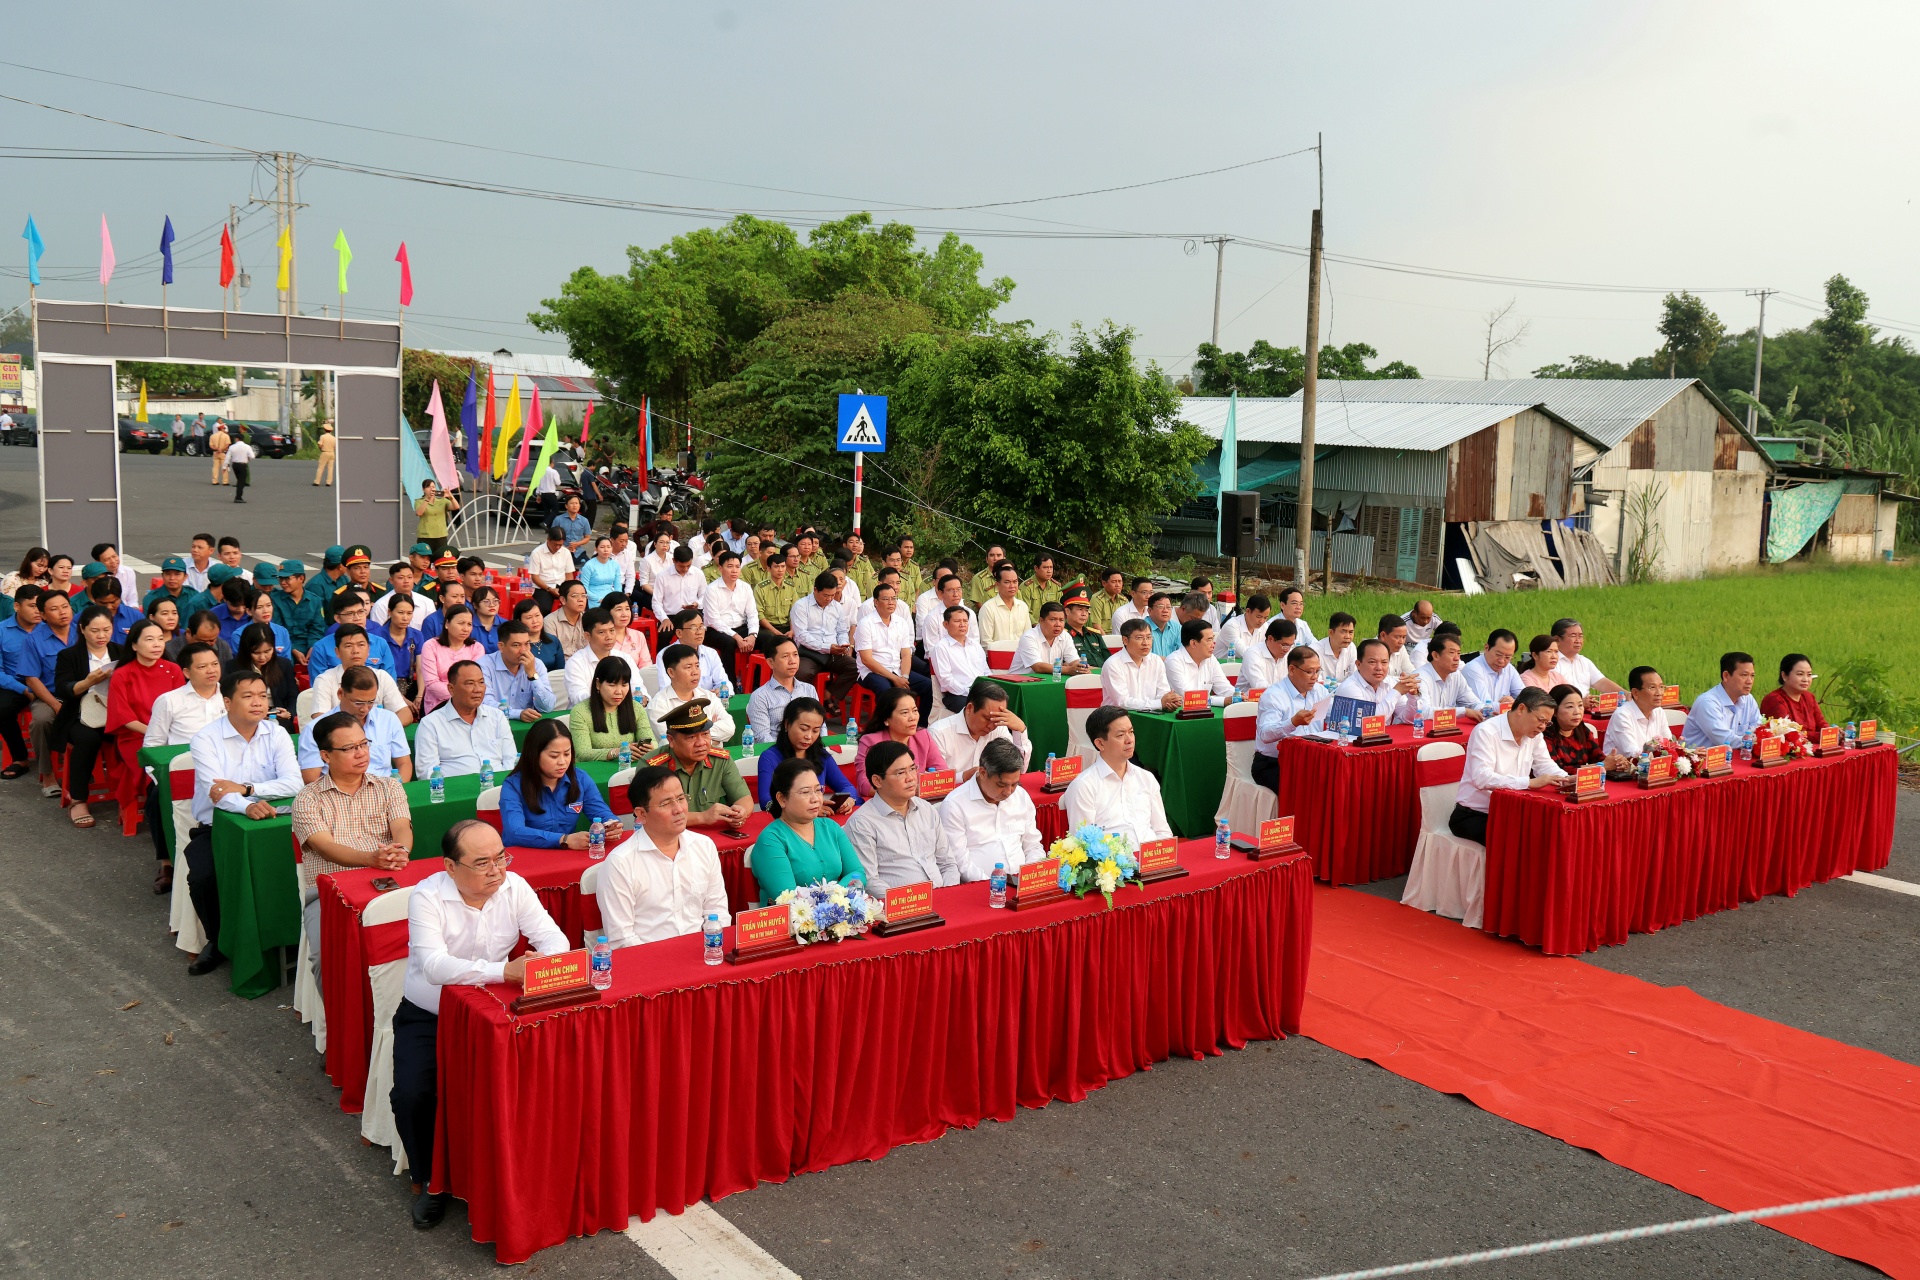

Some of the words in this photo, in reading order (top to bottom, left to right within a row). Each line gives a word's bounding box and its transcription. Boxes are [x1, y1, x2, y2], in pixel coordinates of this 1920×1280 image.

[3, 364, 18, 372] GIA
[2, 373, 19, 381] HUY
[1264, 827, 1269, 836] LÊ
[1270, 827, 1281, 835] QUANG
[1162, 846, 1174, 854] THANH
[1022, 870, 1038, 881] NGUYỄN
[1038, 868, 1048, 877] TUẤN
[742, 920, 756, 932] TRẦN
[757, 920, 768, 929] VĂN
[535, 967, 550, 979] TRẦN
[550, 966, 562, 976] VĂN
[562, 963, 578, 974] CHÍNH
